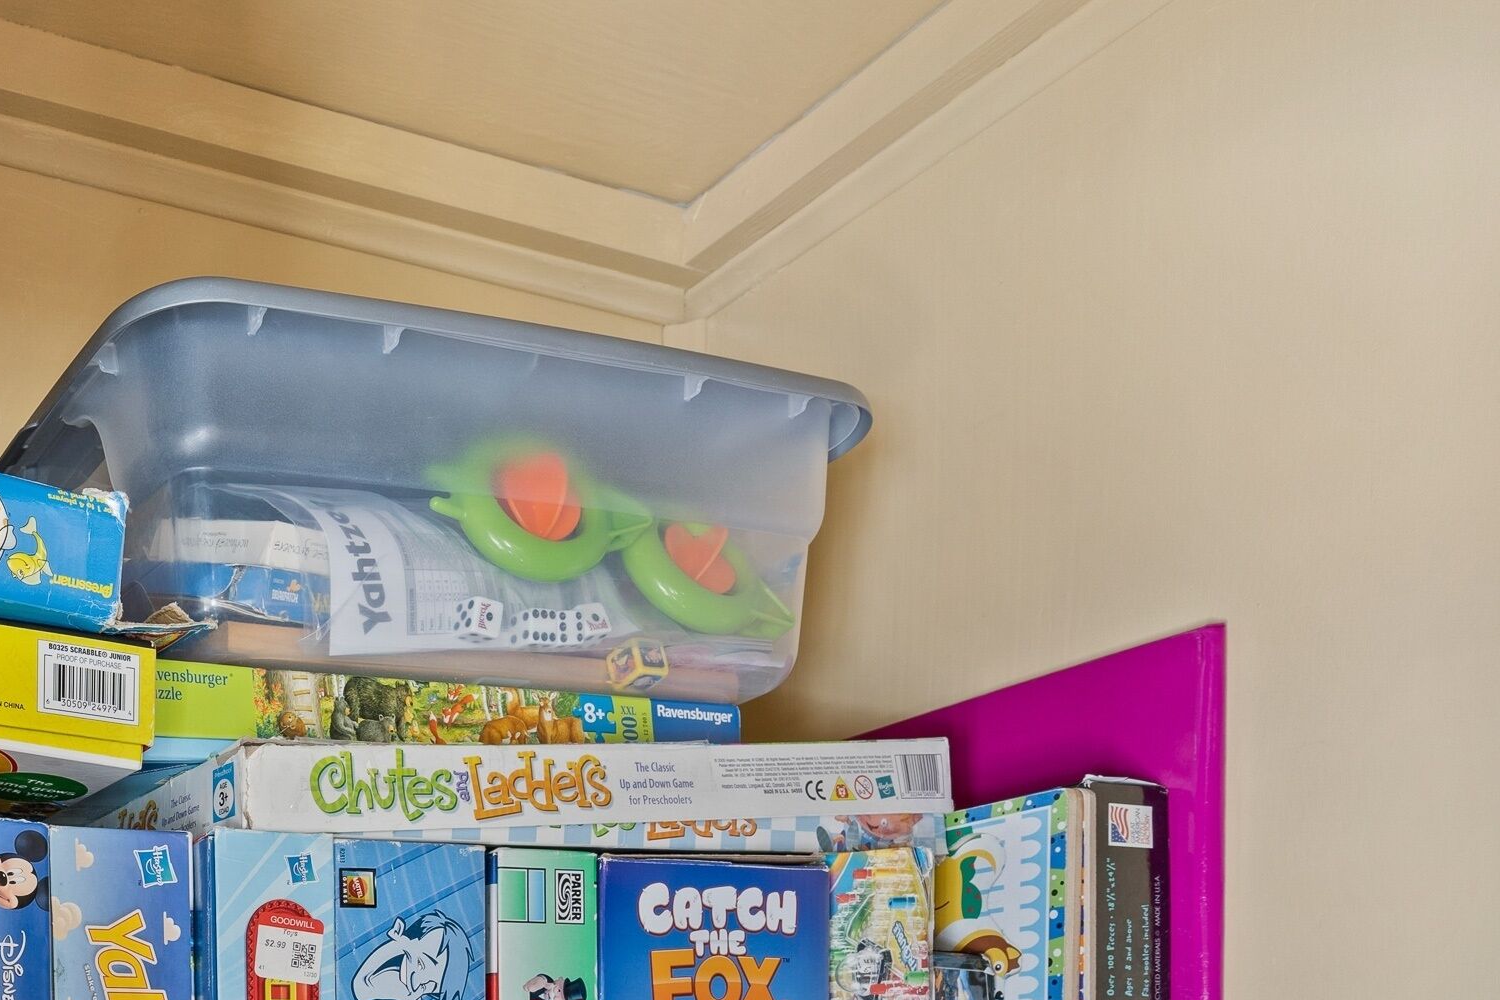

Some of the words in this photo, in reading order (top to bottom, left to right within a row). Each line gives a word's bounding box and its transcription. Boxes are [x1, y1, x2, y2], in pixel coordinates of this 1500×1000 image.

[48, 643, 69, 653] B0325
[108, 652, 132, 662] JUNIOR
[3, 700, 26, 711] CHINA.
[584, 703, 605, 723] 8+
[657, 704, 732, 725] Ravensburger
[635, 762, 650, 773] The
[652, 761, 676, 774] Classic
[310, 749, 455, 821] Chutes
[454, 770, 470, 800] and
[463, 751, 612, 821] Ladders
[619, 778, 632, 792] Up
[633, 778, 646, 790] and
[648, 777, 671, 790] Down
[673, 777, 695, 790] Game
[629, 794, 641, 806] for
[642, 793, 693, 807] Preschoolers
[568, 872, 582, 921] PARKER
[638, 882, 798, 936] CATCH
[270, 915, 315, 929] GOODWILL
[264, 939, 287, 949] $2.99
[689, 929, 747, 957] THE
